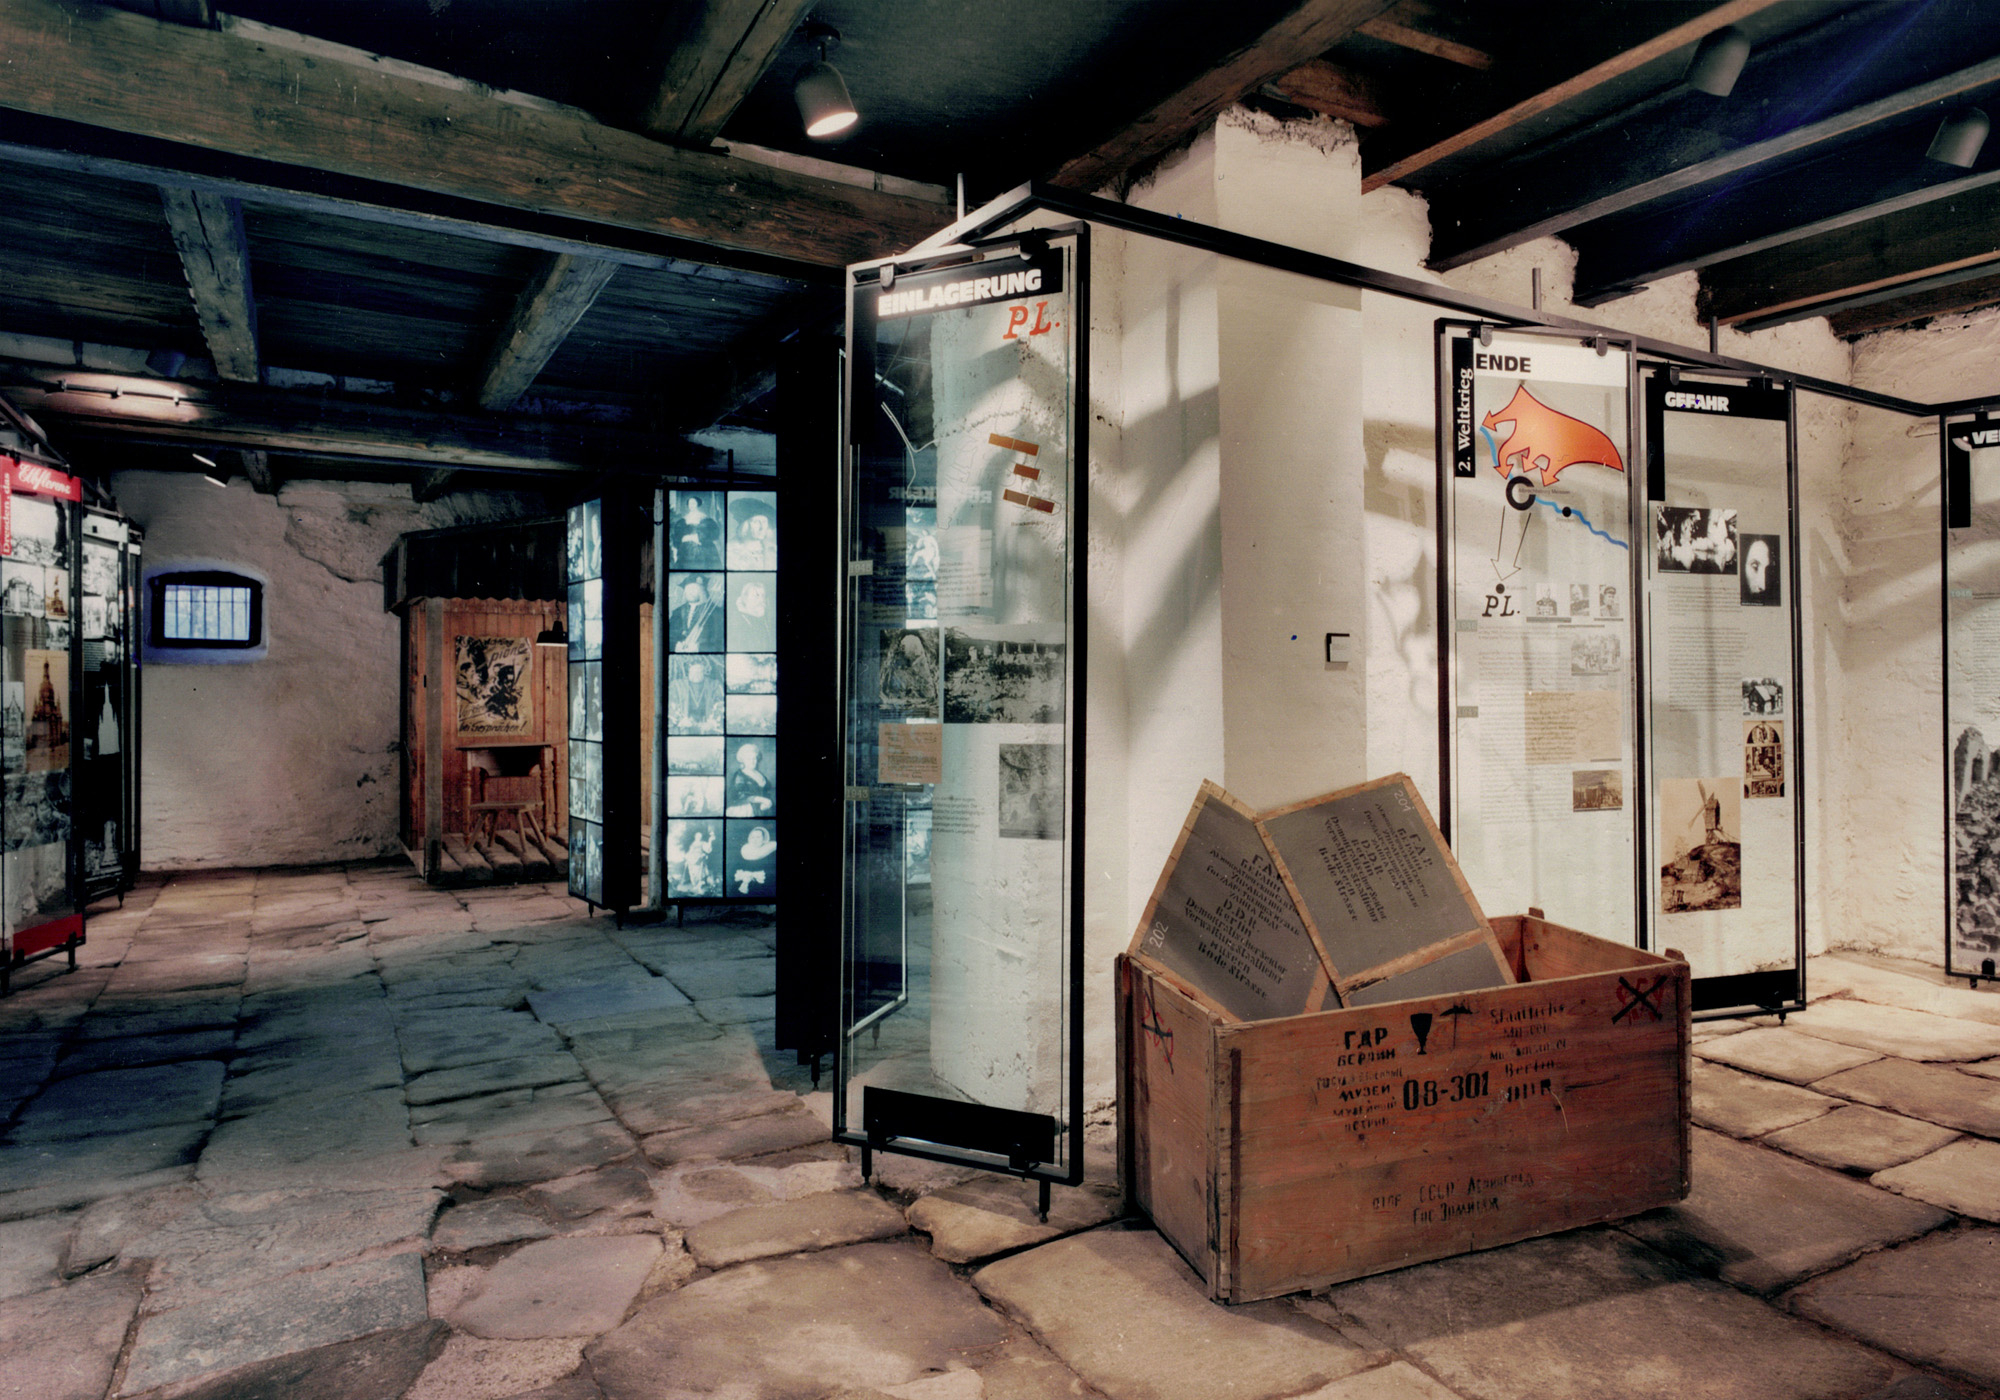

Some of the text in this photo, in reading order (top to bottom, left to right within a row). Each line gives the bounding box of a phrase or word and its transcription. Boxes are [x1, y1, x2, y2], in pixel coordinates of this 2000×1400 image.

[878, 269, 1042, 317] EINLAGERUNG
[1476, 353, 1531, 373] ENDE
[1457, 368, 1474, 451] Weltkrieg
[1664, 391, 1730, 412] GEFAHR
[1971, 429, 2000, 445] VE
[1394, 790, 1412, 812] 201
[1149, 921, 1169, 948] 202
[1344, 1027, 1388, 1050] ГДР
[1403, 1071, 1490, 1111] 08-301
